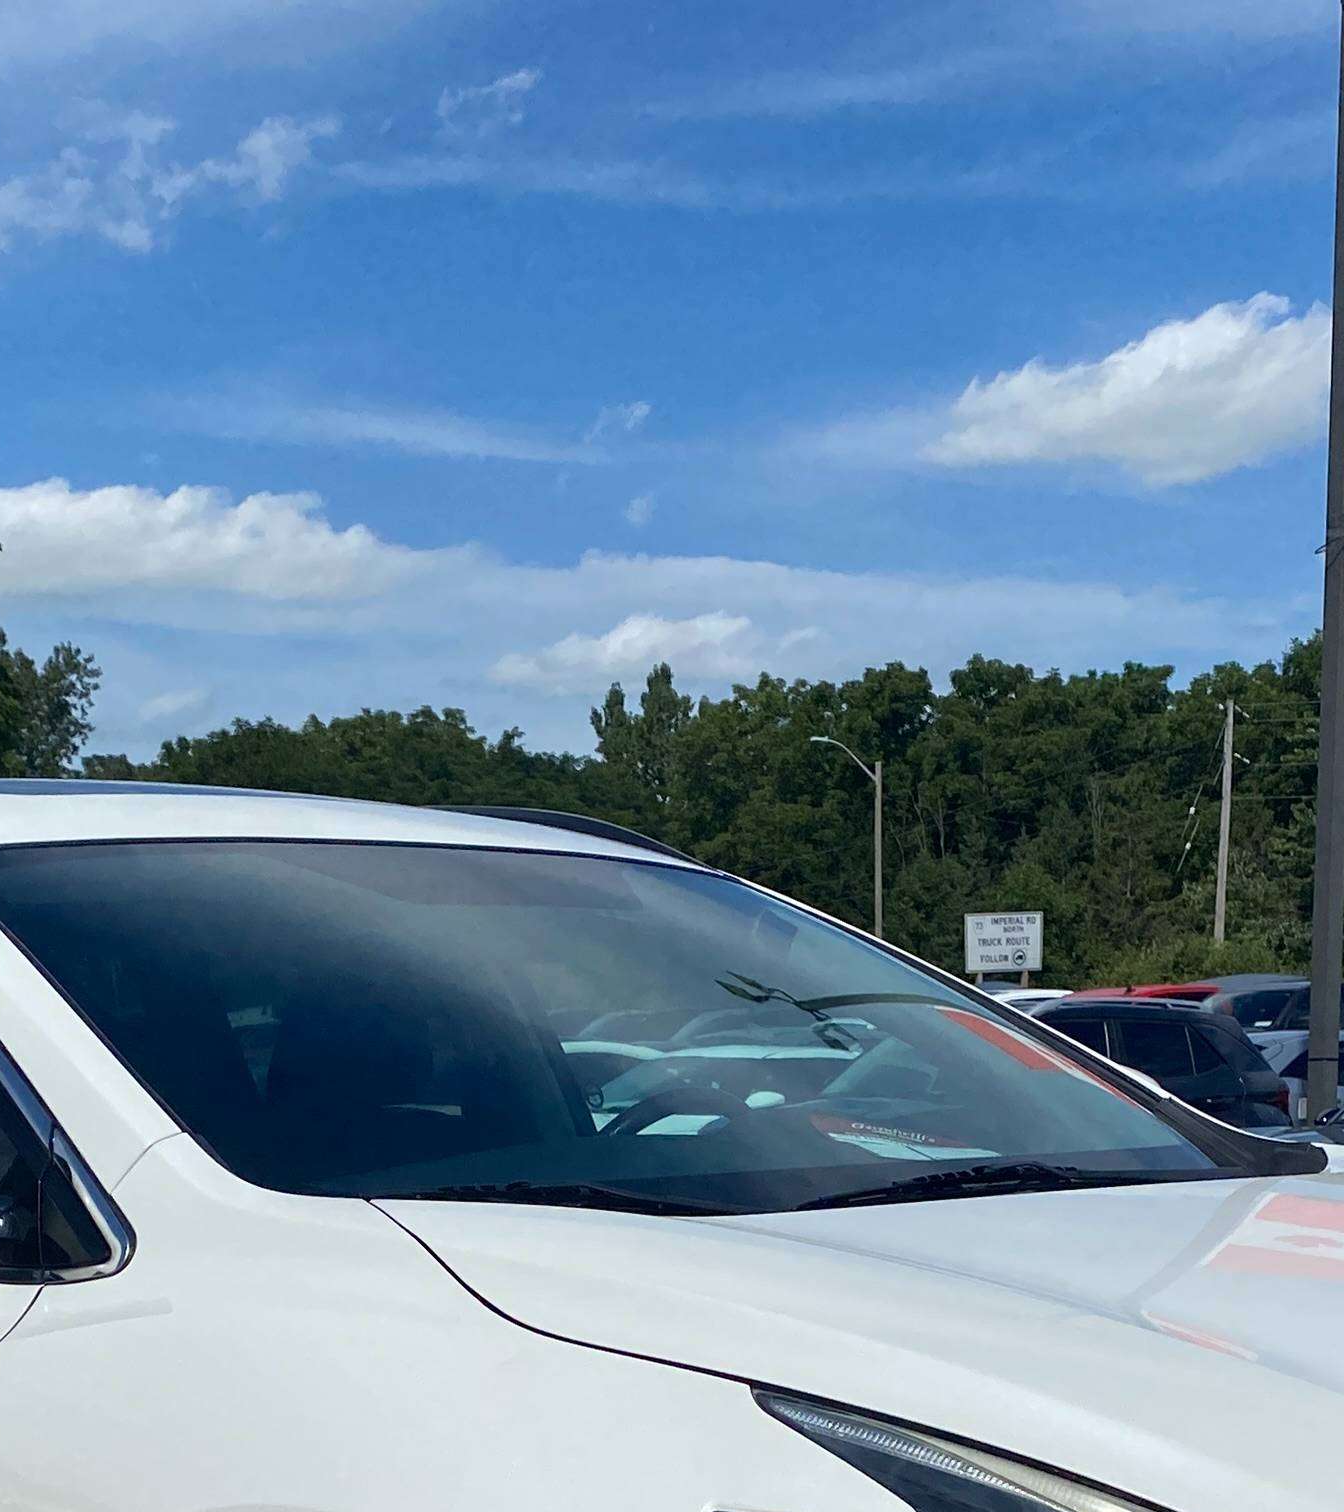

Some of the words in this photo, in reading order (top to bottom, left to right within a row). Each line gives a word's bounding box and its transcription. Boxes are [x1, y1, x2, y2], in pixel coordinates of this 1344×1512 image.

[990, 916, 1025, 926] IMPERIAL
[1027, 916, 1036, 925] RD
[978, 938, 1003, 947] TRUCK
[1006, 937, 1031, 947] ROUTE
